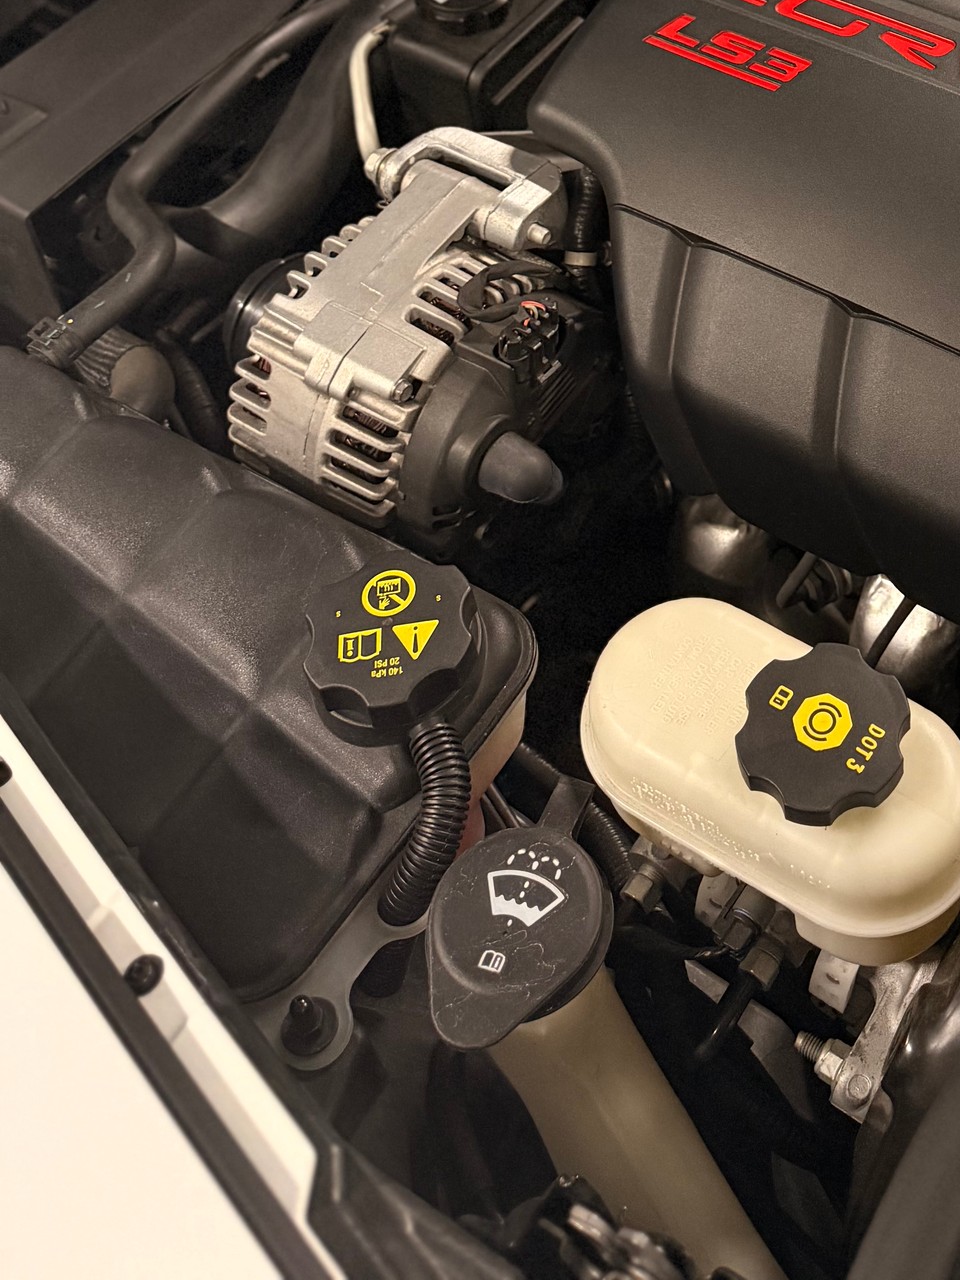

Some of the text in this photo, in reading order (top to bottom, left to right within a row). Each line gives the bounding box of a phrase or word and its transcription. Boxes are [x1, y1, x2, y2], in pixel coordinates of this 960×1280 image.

[648, 12, 813, 87] LS3
[370, 666, 404, 679] 140 kPa
[374, 656, 400, 669] 20 PSI
[845, 723, 886, 774] DOT 3
